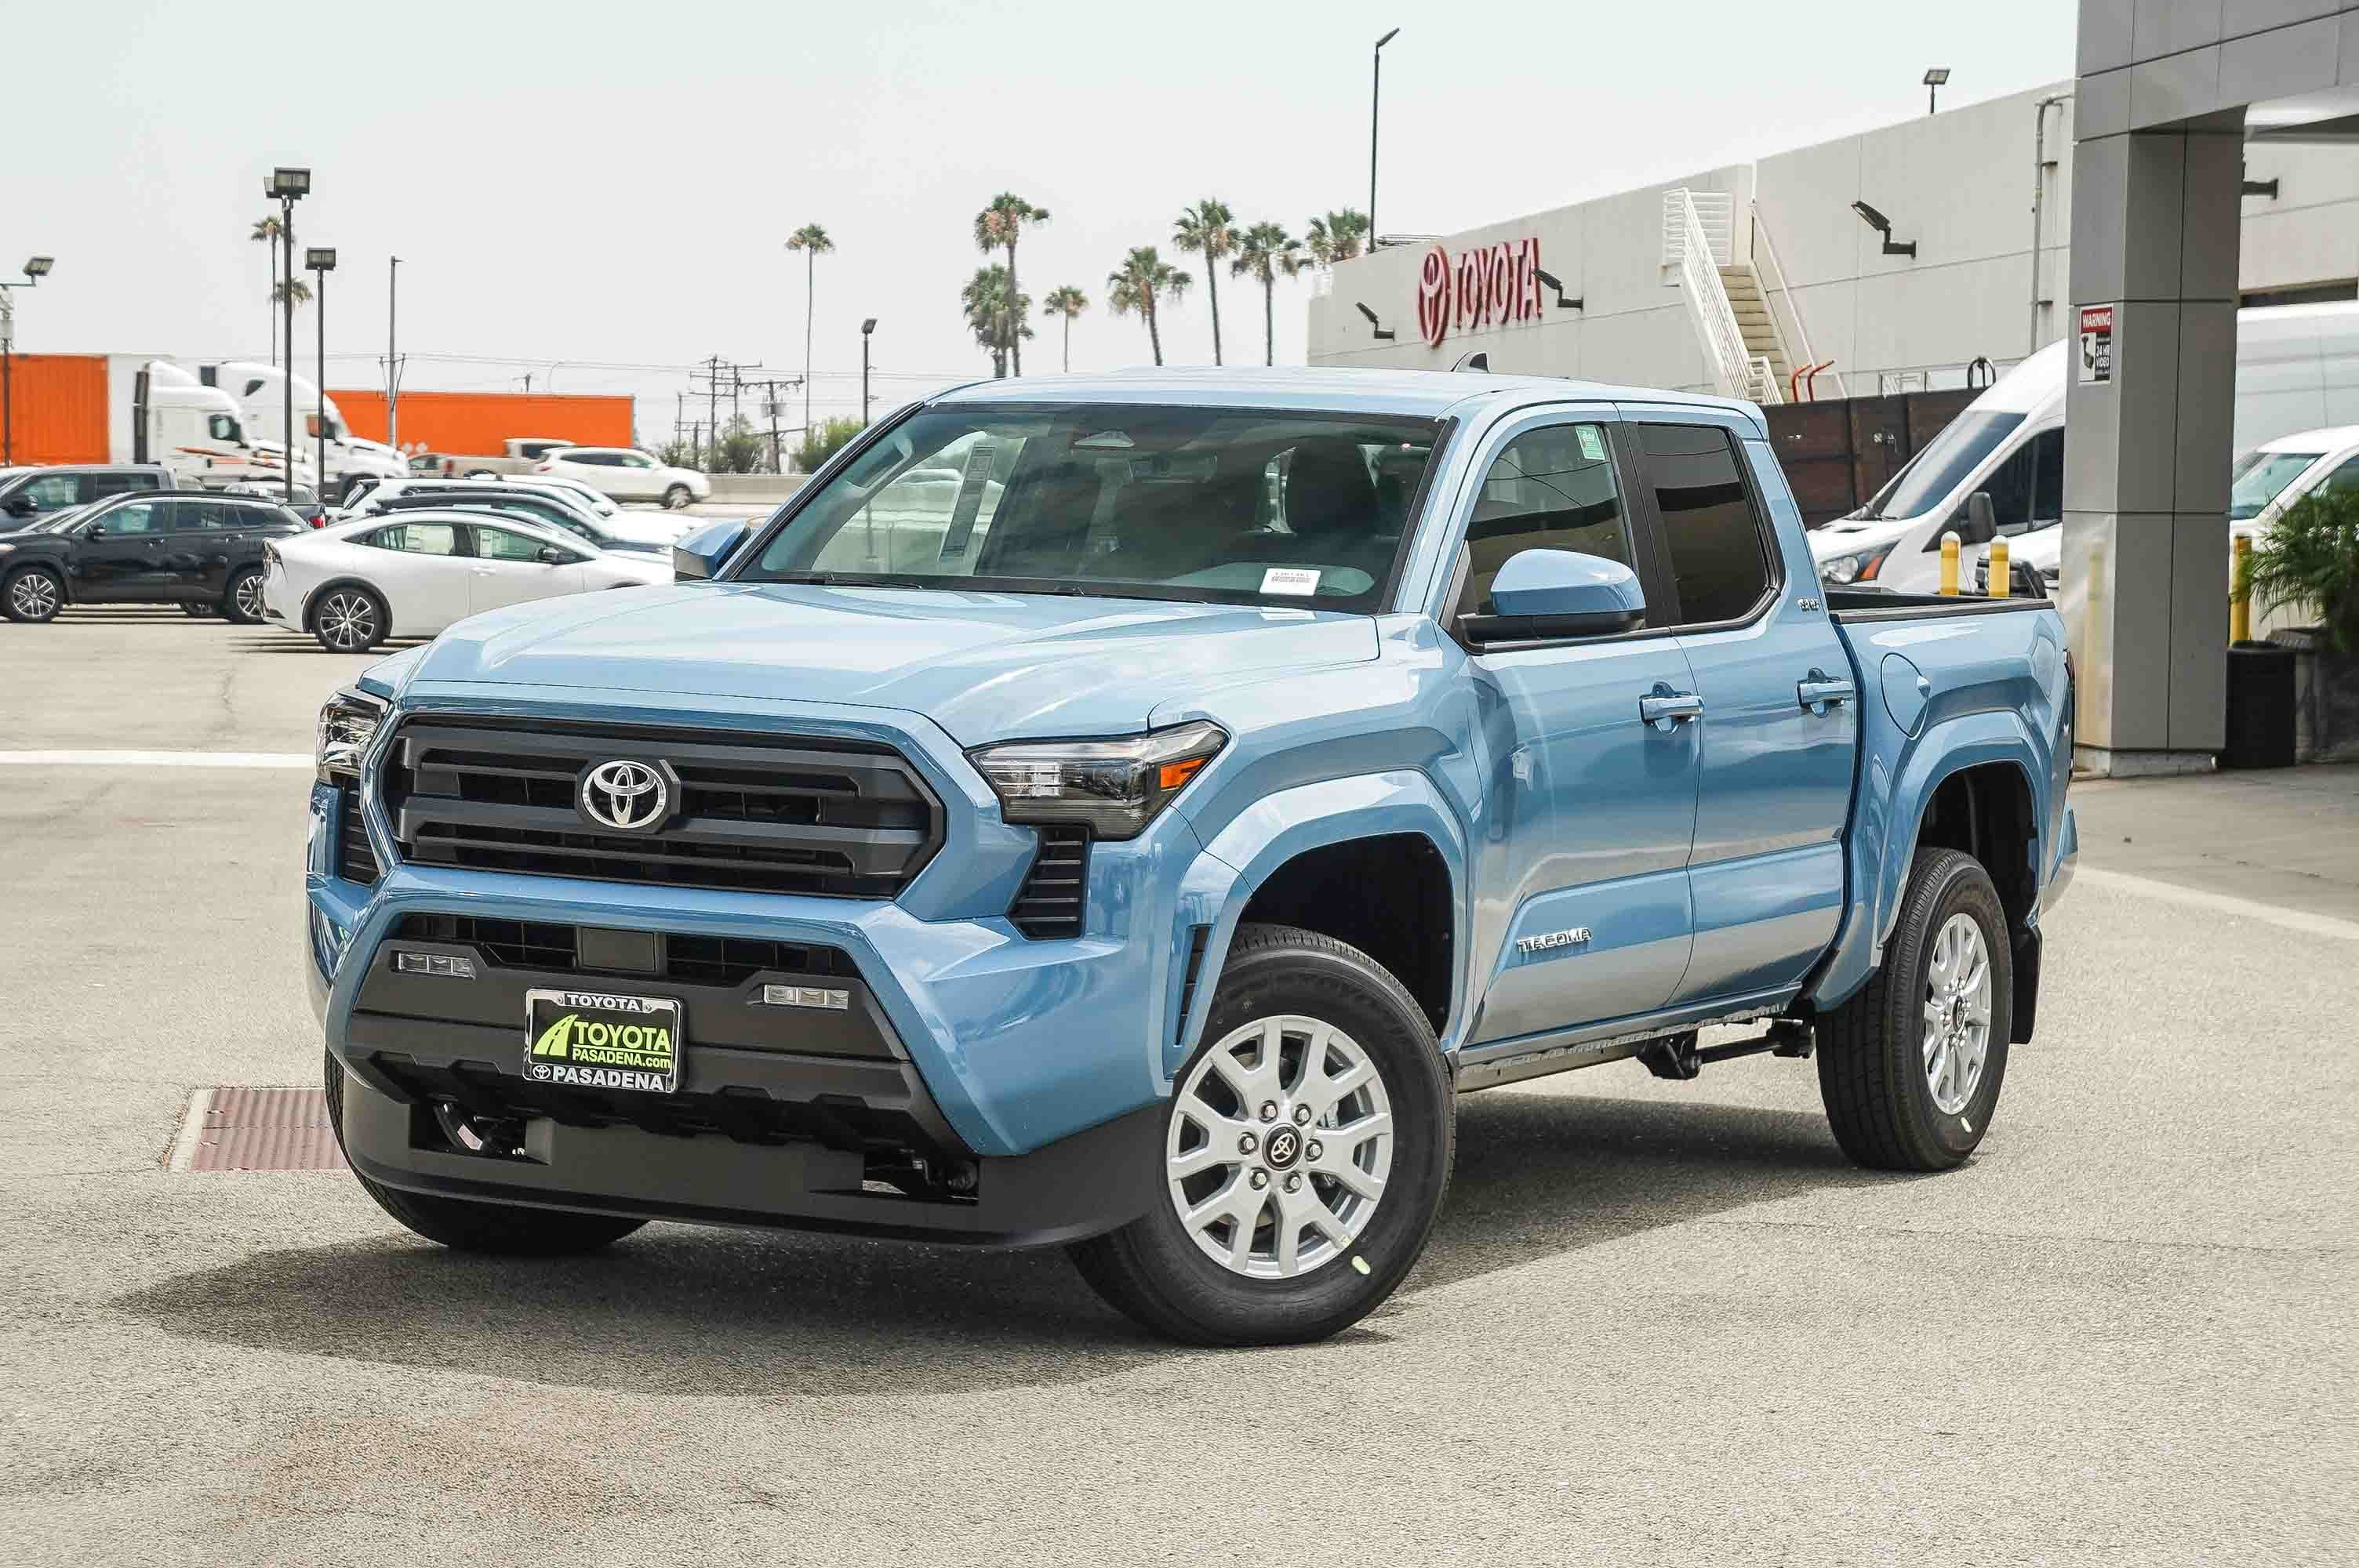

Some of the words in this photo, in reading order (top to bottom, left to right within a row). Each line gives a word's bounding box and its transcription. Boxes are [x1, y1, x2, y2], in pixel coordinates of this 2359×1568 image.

[1451, 238, 1543, 331] TOYOTA
[2082, 312, 2111, 327] WARNING
[1517, 927, 1593, 953] TACOMA
[567, 994, 640, 1011] TOYOTA
[574, 1021, 671, 1051] TOYOTA
[572, 1047, 671, 1069] PASADENA.com
[552, 1065, 664, 1091] PASADENA
